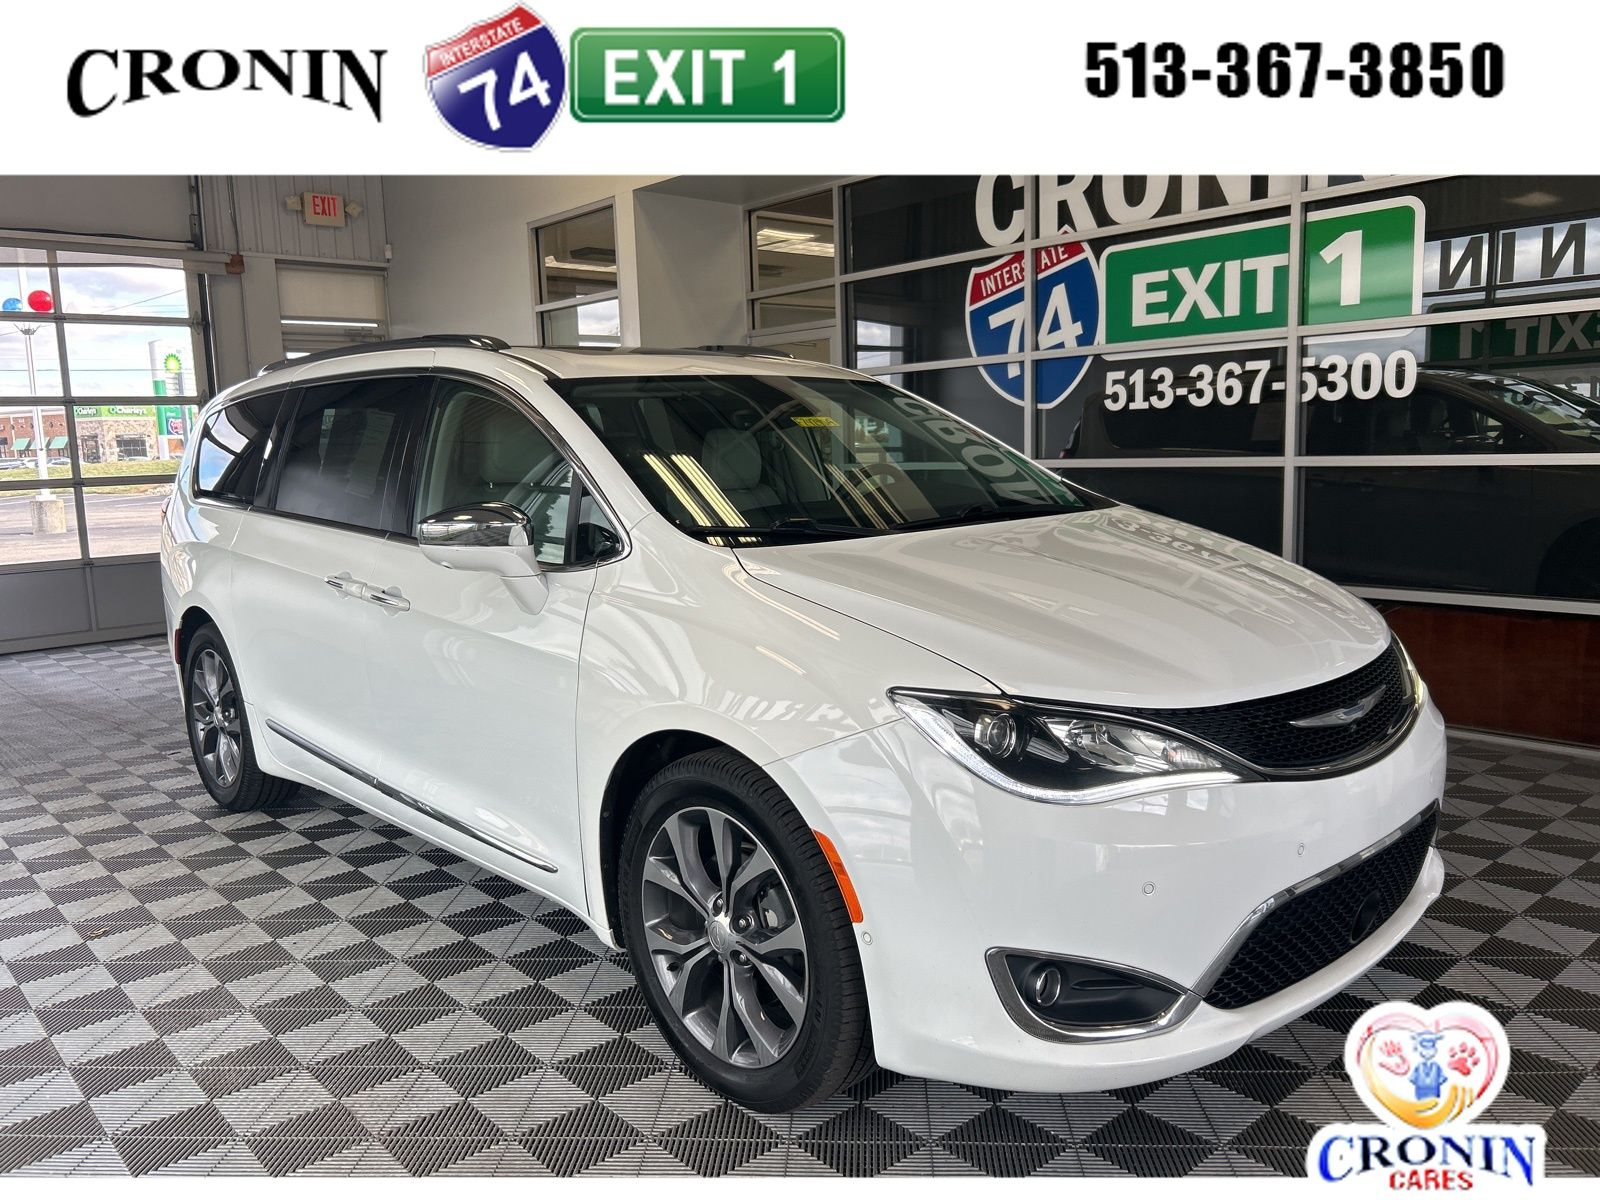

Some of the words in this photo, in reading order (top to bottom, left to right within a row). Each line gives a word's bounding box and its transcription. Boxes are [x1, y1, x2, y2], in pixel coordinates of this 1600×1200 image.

[312, 195, 337, 217] EXIT
[980, 246, 1069, 297] INTERATE
[1132, 252, 1289, 328] EXIT
[1319, 230, 1363, 306] 1
[988, 282, 1084, 380] 74
[1103, 349, 1418, 412] 513-367-5300
